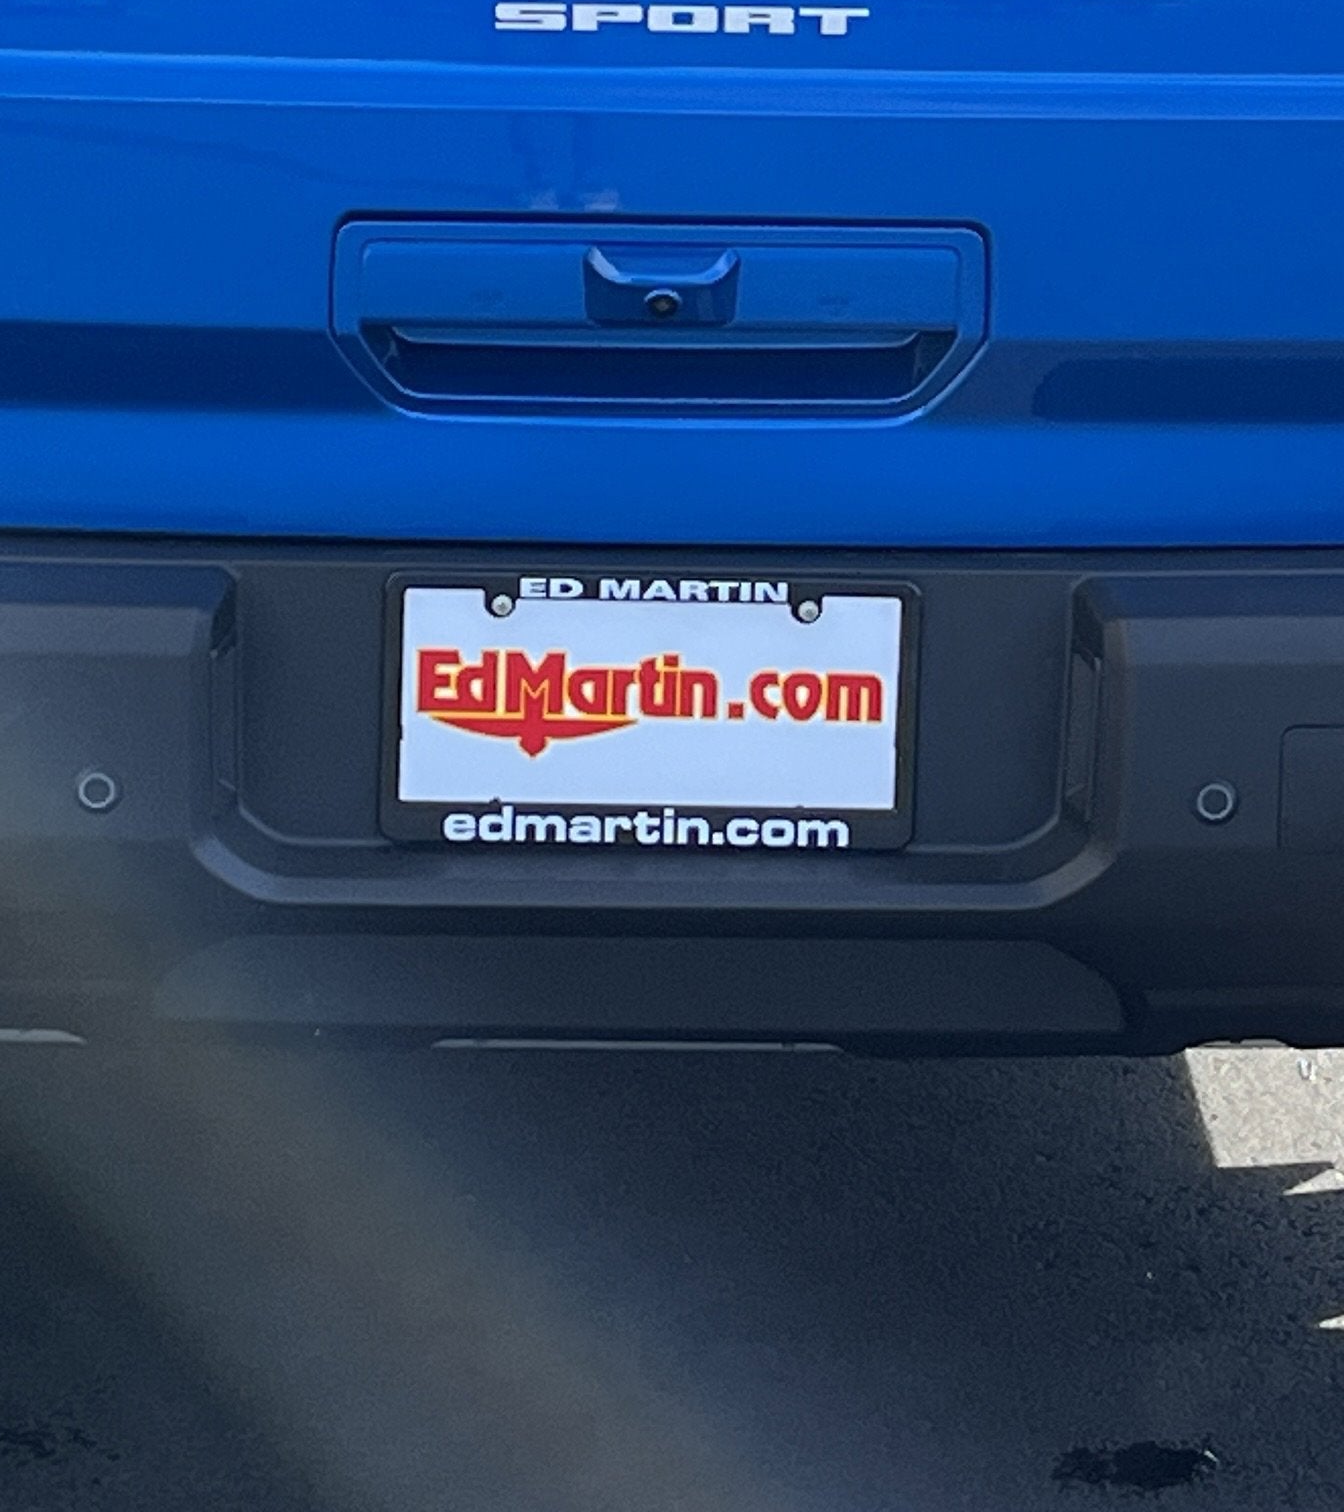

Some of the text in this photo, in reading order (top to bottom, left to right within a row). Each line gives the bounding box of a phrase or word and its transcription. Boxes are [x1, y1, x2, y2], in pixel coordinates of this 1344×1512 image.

[494, 2, 870, 36] SPORT
[520, 577, 789, 603] ED MARTIN
[417, 648, 883, 724] EdMartin.com
[443, 806, 850, 848] edmartin.com
